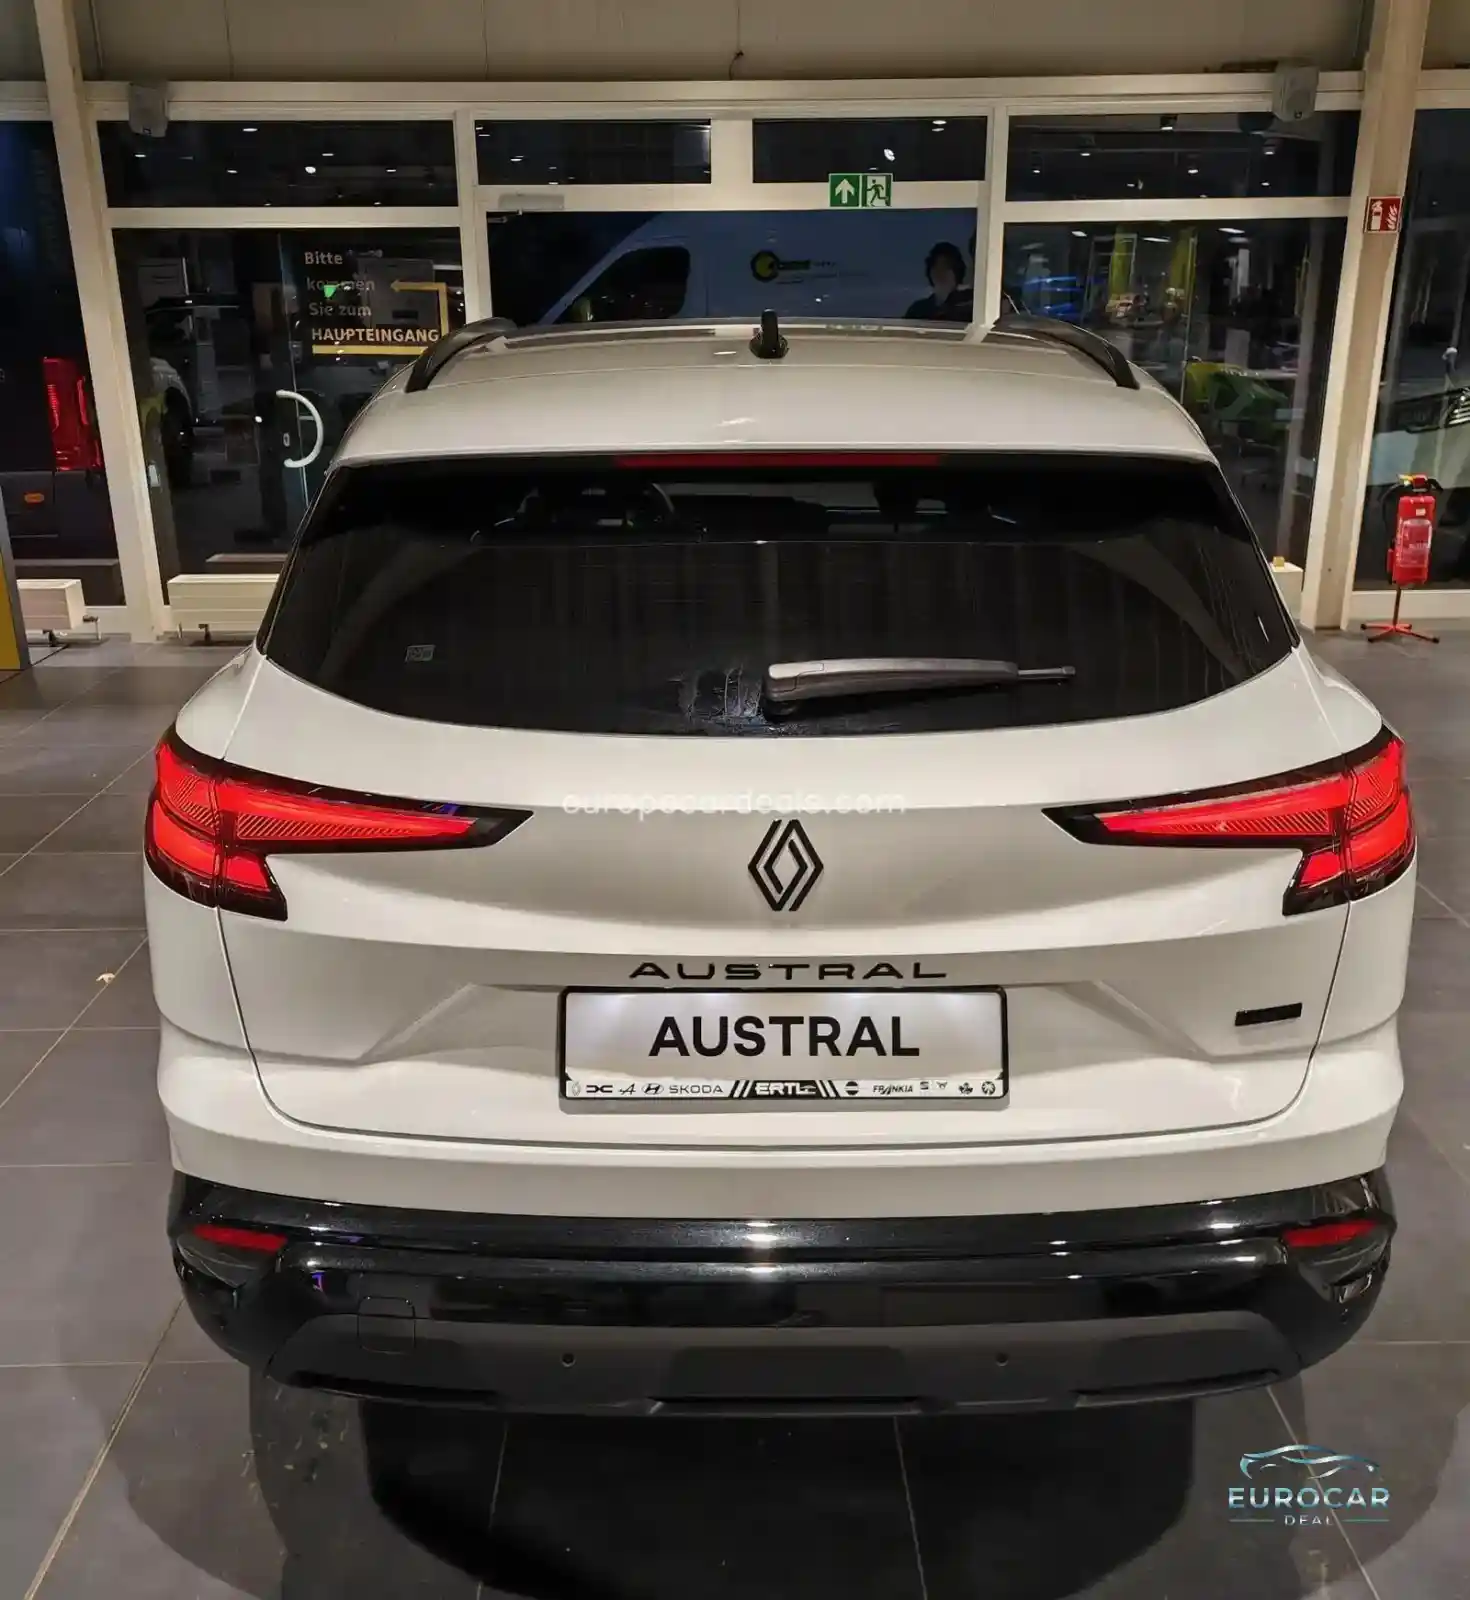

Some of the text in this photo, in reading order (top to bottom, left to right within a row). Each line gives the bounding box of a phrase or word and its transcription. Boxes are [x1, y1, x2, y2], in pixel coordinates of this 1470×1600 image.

[304, 251, 343, 265] Bitte
[309, 302, 372, 316] Sie zum
[311, 327, 439, 342] HAUPTEINGANG
[629, 962, 947, 980] AUSTRAL
[648, 1016, 920, 1057] AUSTRAL
